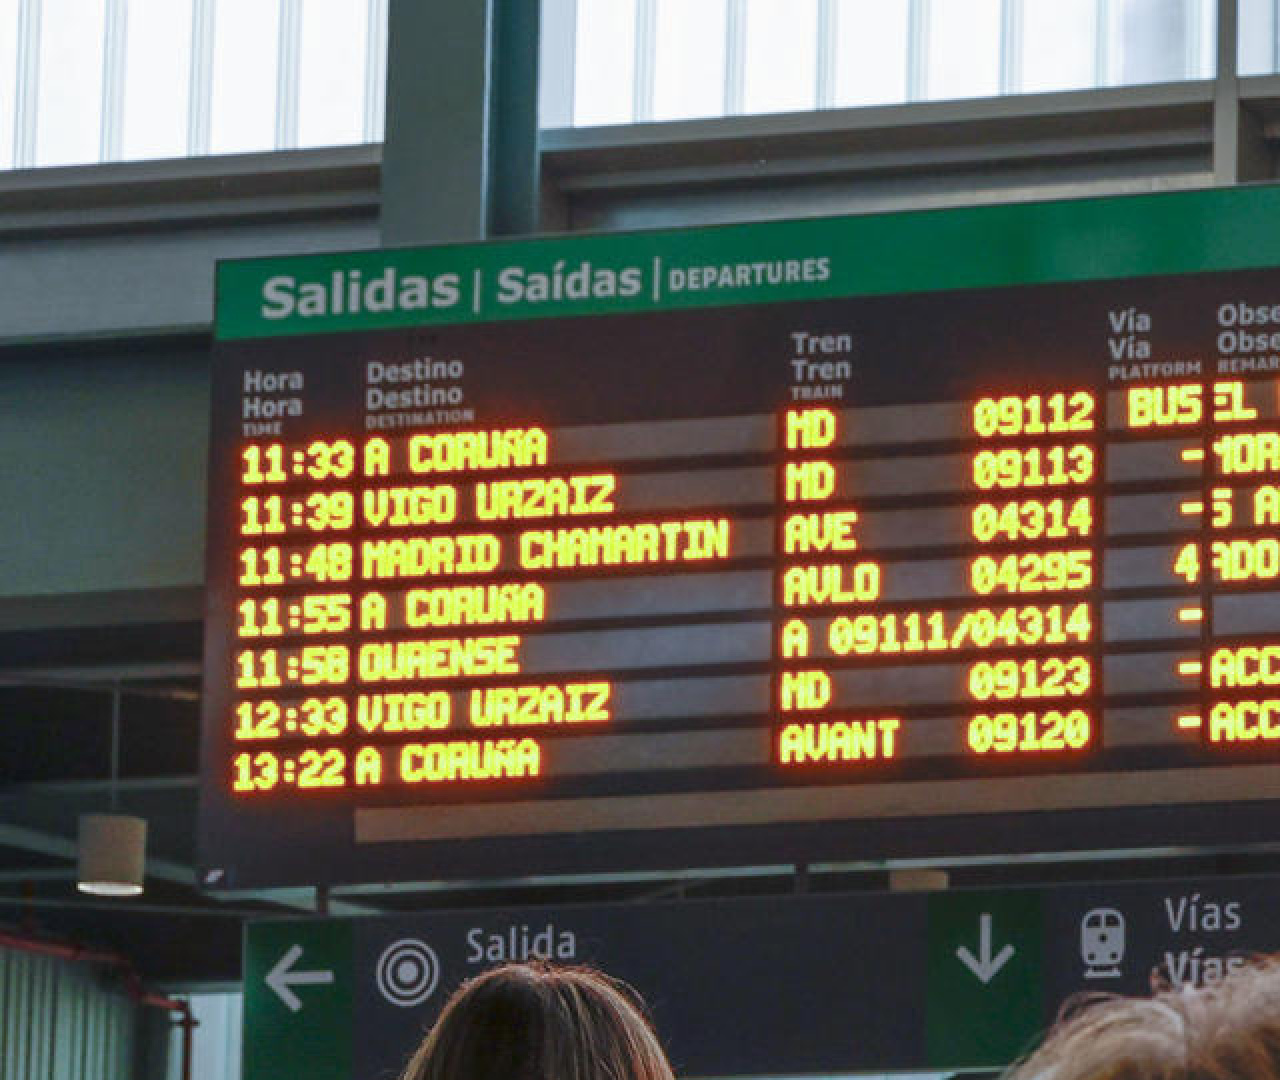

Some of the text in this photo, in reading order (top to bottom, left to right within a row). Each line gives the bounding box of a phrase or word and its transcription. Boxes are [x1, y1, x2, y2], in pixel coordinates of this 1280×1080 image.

[262, 257, 830, 319] Salidas Saídas DEPARTURES
[1109, 308, 1151, 333] Vía
[792, 332, 851, 354] Tren
[1108, 335, 1150, 360] Vía
[244, 370, 304, 392] Hora
[367, 357, 464, 384] Destino
[791, 359, 851, 381] Tren
[1109, 361, 1201, 380] PLATFORM
[366, 384, 463, 410] Destino
[791, 385, 843, 400] TRAIN
[243, 397, 302, 418] Hora
[365, 409, 475, 430] DESTINATION
[243, 421, 282, 437] TIME
[244, 440, 354, 484] 11:33
[364, 438, 390, 476] A
[410, 428, 546, 472] CORUÑA
[788, 410, 836, 448] MD
[974, 392, 1094, 436] 09112
[1128, 384, 1202, 426] BUS
[242, 492, 354, 534] 11:39
[364, 486, 456, 526] VIGO
[476, 474, 614, 520] URZAIZ
[786, 462, 834, 500] MD
[974, 446, 1094, 488] 09113
[240, 544, 352, 586] 11:48
[362, 534, 500, 578] MADRID
[520, 520, 728, 568] CHAMARTIN
[784, 512, 856, 552] AVE
[972, 498, 1092, 542] 04314
[238, 594, 350, 636] 11:55
[360, 592, 386, 630] A
[406, 584, 544, 628] CORUÑA
[784, 562, 880, 606] AVLO
[972, 550, 1092, 594] 04295
[238, 604, 1090, 688] 11:58 OURENSE A 09111/04314
[236, 698, 348, 738] 12:33
[358, 692, 450, 732] VIGO
[470, 682, 610, 726] URZAIZ
[782, 672, 830, 710] MD
[970, 656, 1090, 700] 09123
[234, 750, 346, 790] 13:22
[356, 746, 382, 784] A
[400, 738, 540, 782] CORUÑA
[780, 720, 900, 762] AVANT
[968, 710, 1090, 752] 09120
[1165, 893, 1241, 932] Vías
[466, 923, 577, 963] Salida
